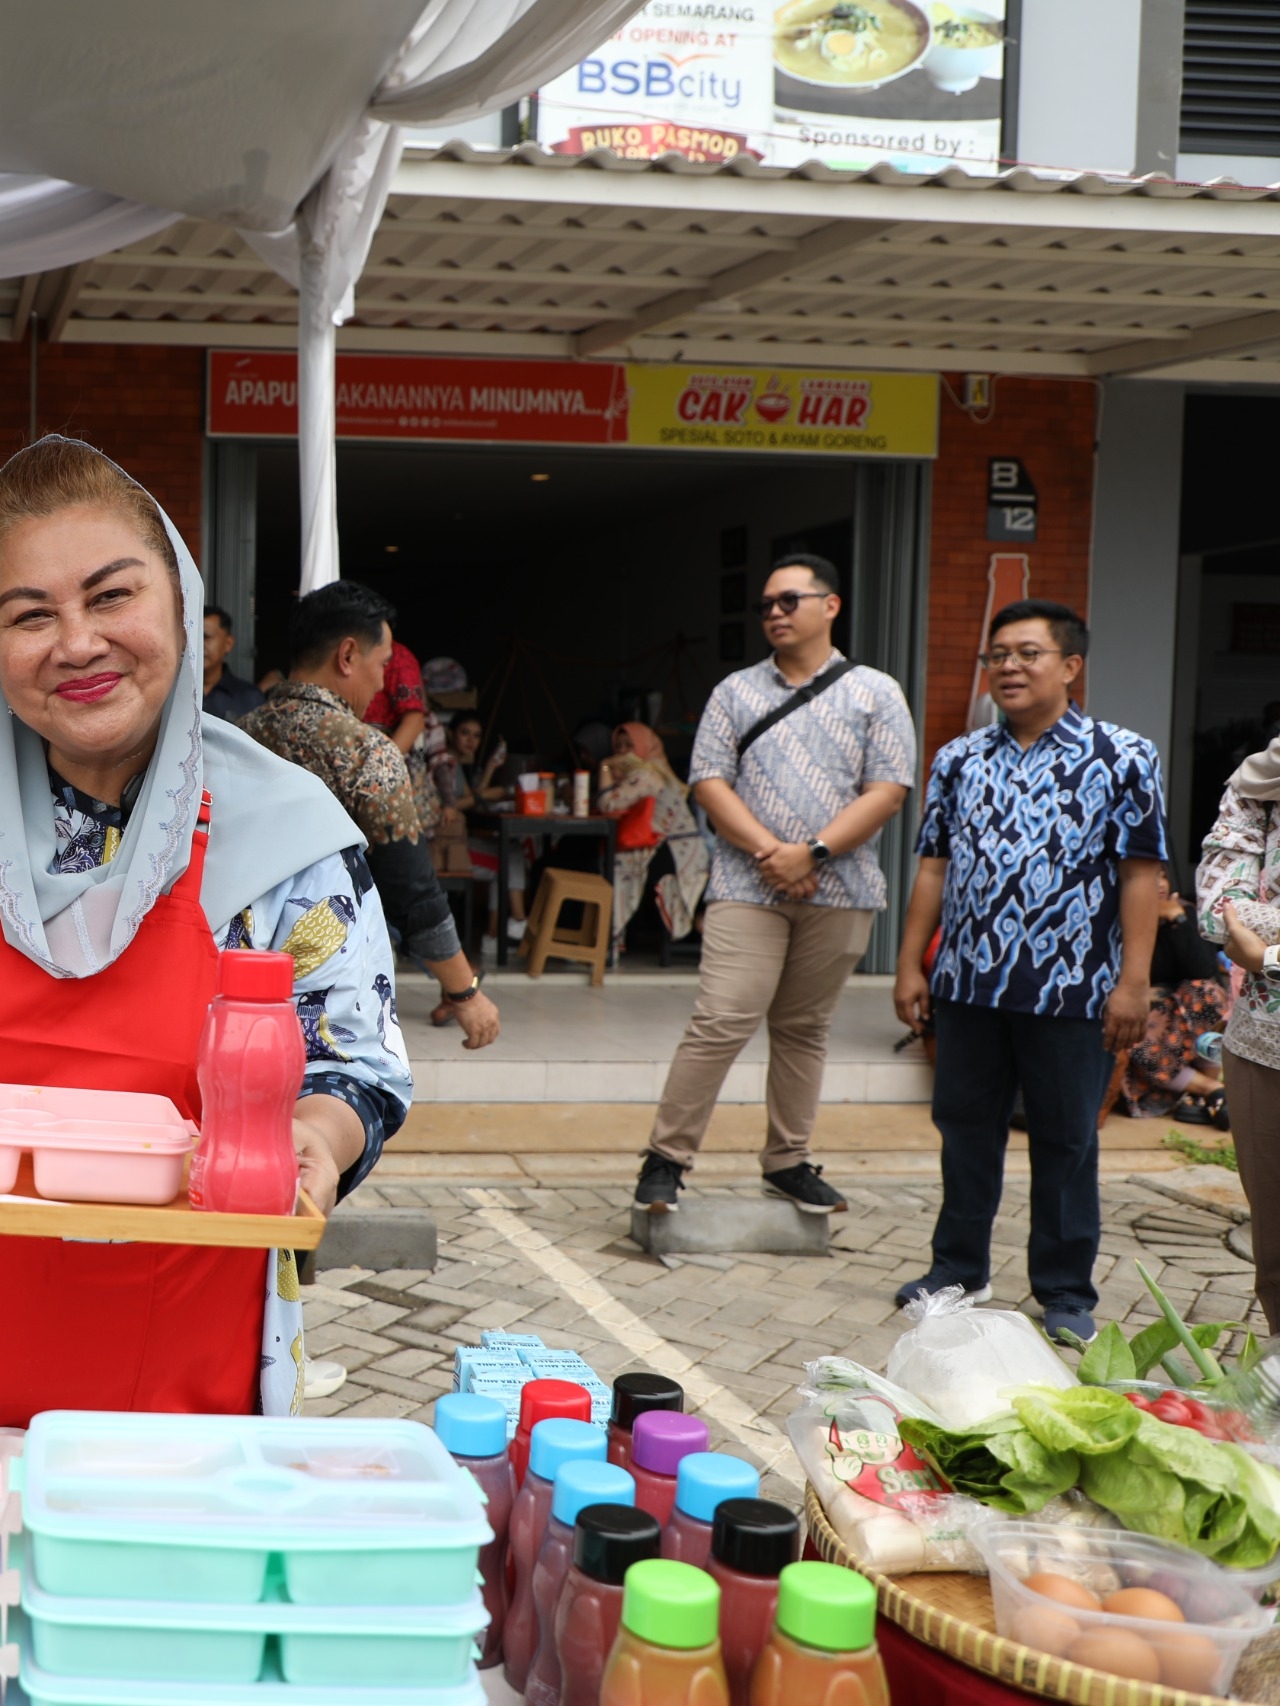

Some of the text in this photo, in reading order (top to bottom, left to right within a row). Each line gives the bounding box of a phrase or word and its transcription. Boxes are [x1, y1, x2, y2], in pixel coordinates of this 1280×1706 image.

[654, 3, 755, 22] SEMARANG
[630, 28, 708, 46] OPENING
[714, 34, 738, 47] AT
[581, 127, 642, 150] RUKO
[651, 125, 739, 158] PASMOD
[799, 126, 925, 151] Sponsored
[934, 133, 961, 157] by
[224, 380, 300, 407] APAPU
[335, 383, 466, 410] AKANANNYA
[678, 387, 869, 428] CAK HAR
[660, 428, 888, 449] SPESIAL SOTO & AYAM GORENG
[991, 461, 1019, 488] B
[1002, 506, 1034, 531] 12
